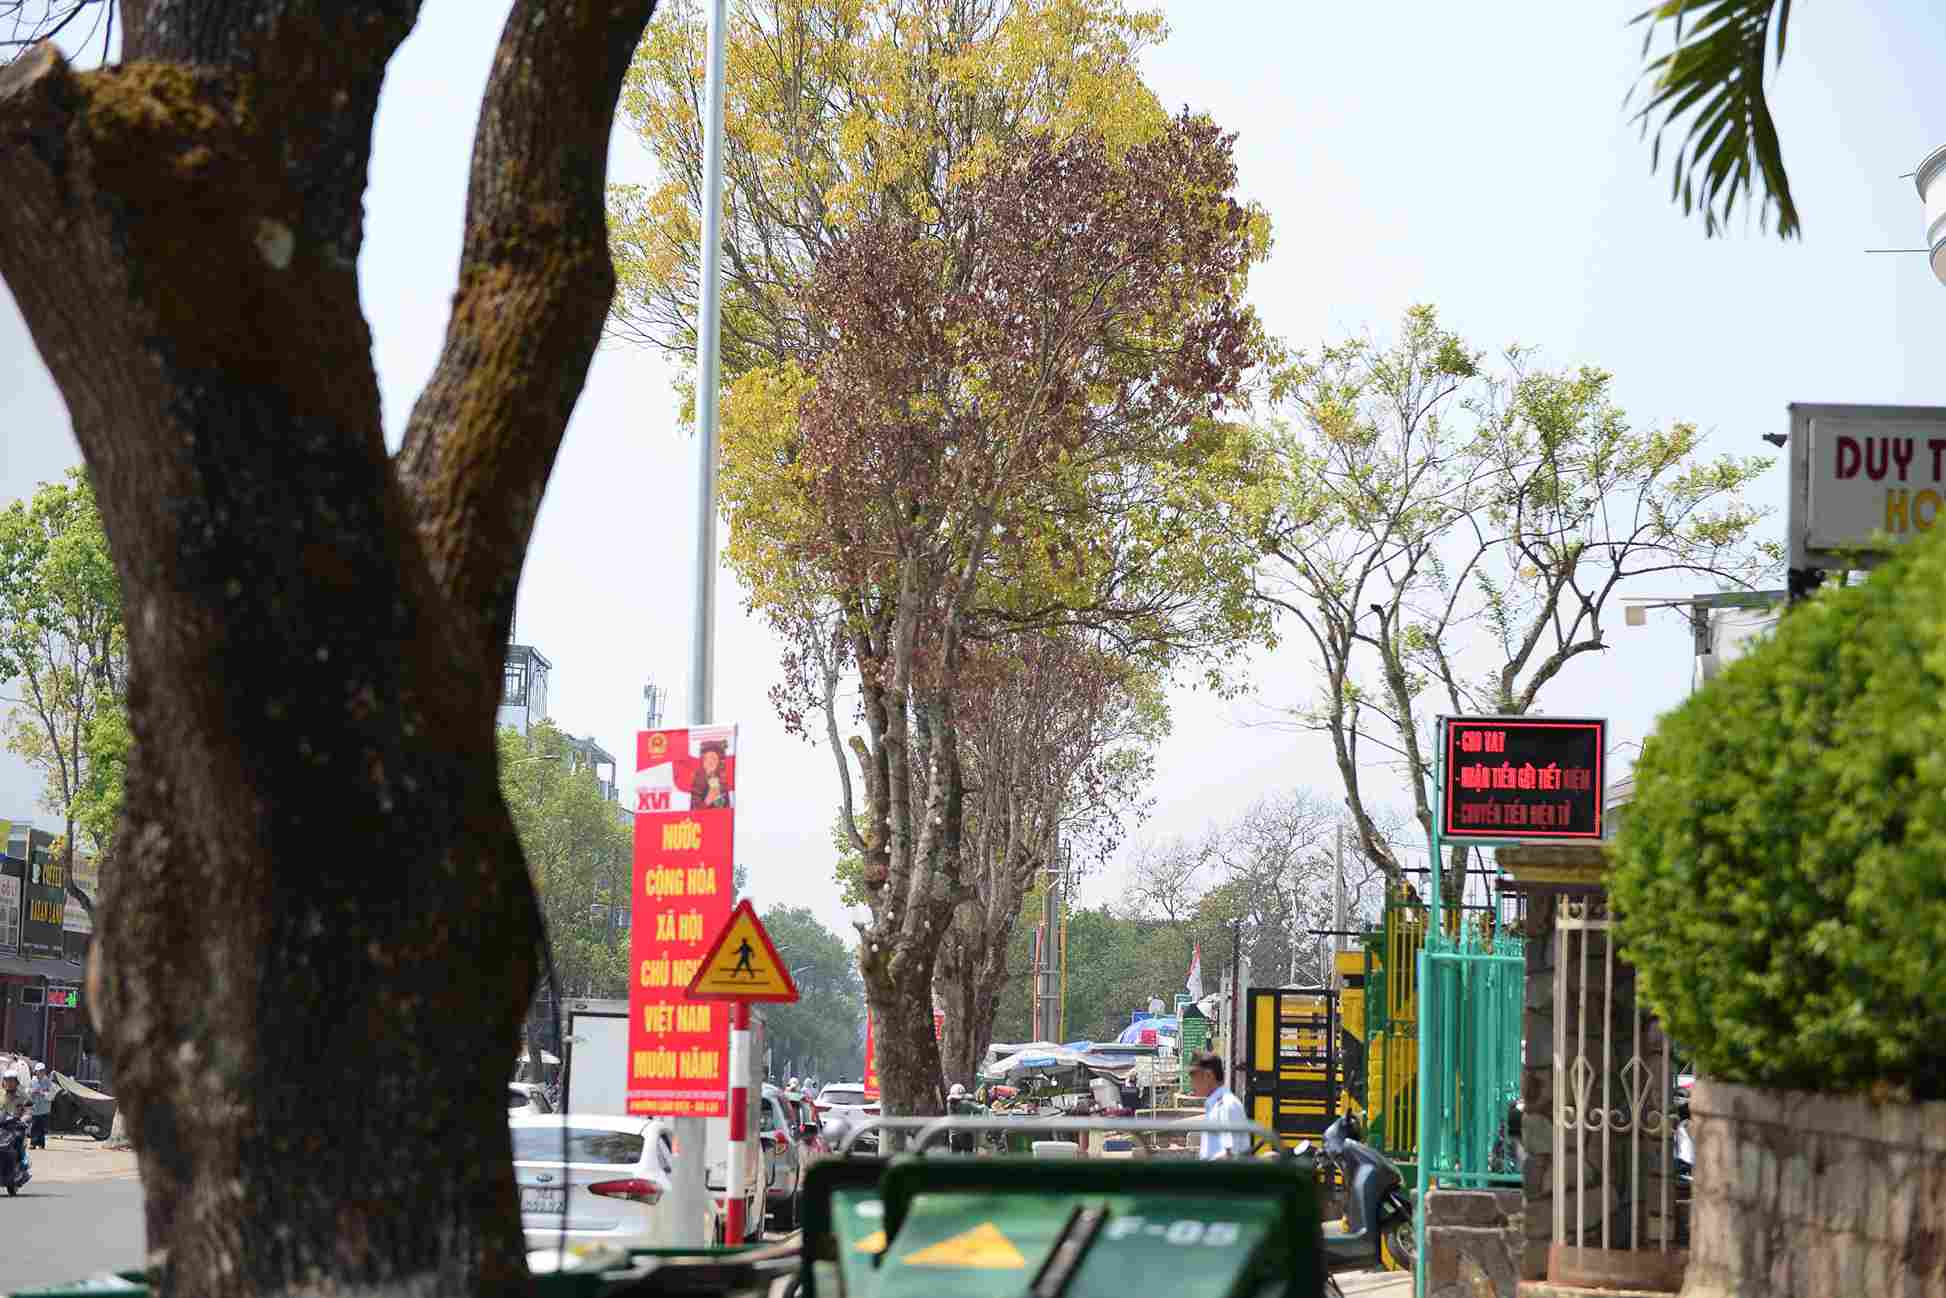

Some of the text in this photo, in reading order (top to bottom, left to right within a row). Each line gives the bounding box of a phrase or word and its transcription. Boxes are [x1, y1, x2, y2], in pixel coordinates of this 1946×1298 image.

[1836, 435, 1914, 482] DUY
[638, 790, 671, 810] XVI
[662, 817, 702, 850] NƯỚC
[645, 864, 684, 902] CỘNG
[656, 908, 704, 946] XÃ HỘI
[640, 950, 670, 986] CHỦ
[644, 1000, 711, 1039] VIỆT NAM
[633, 1046, 677, 1079] MUÔN
